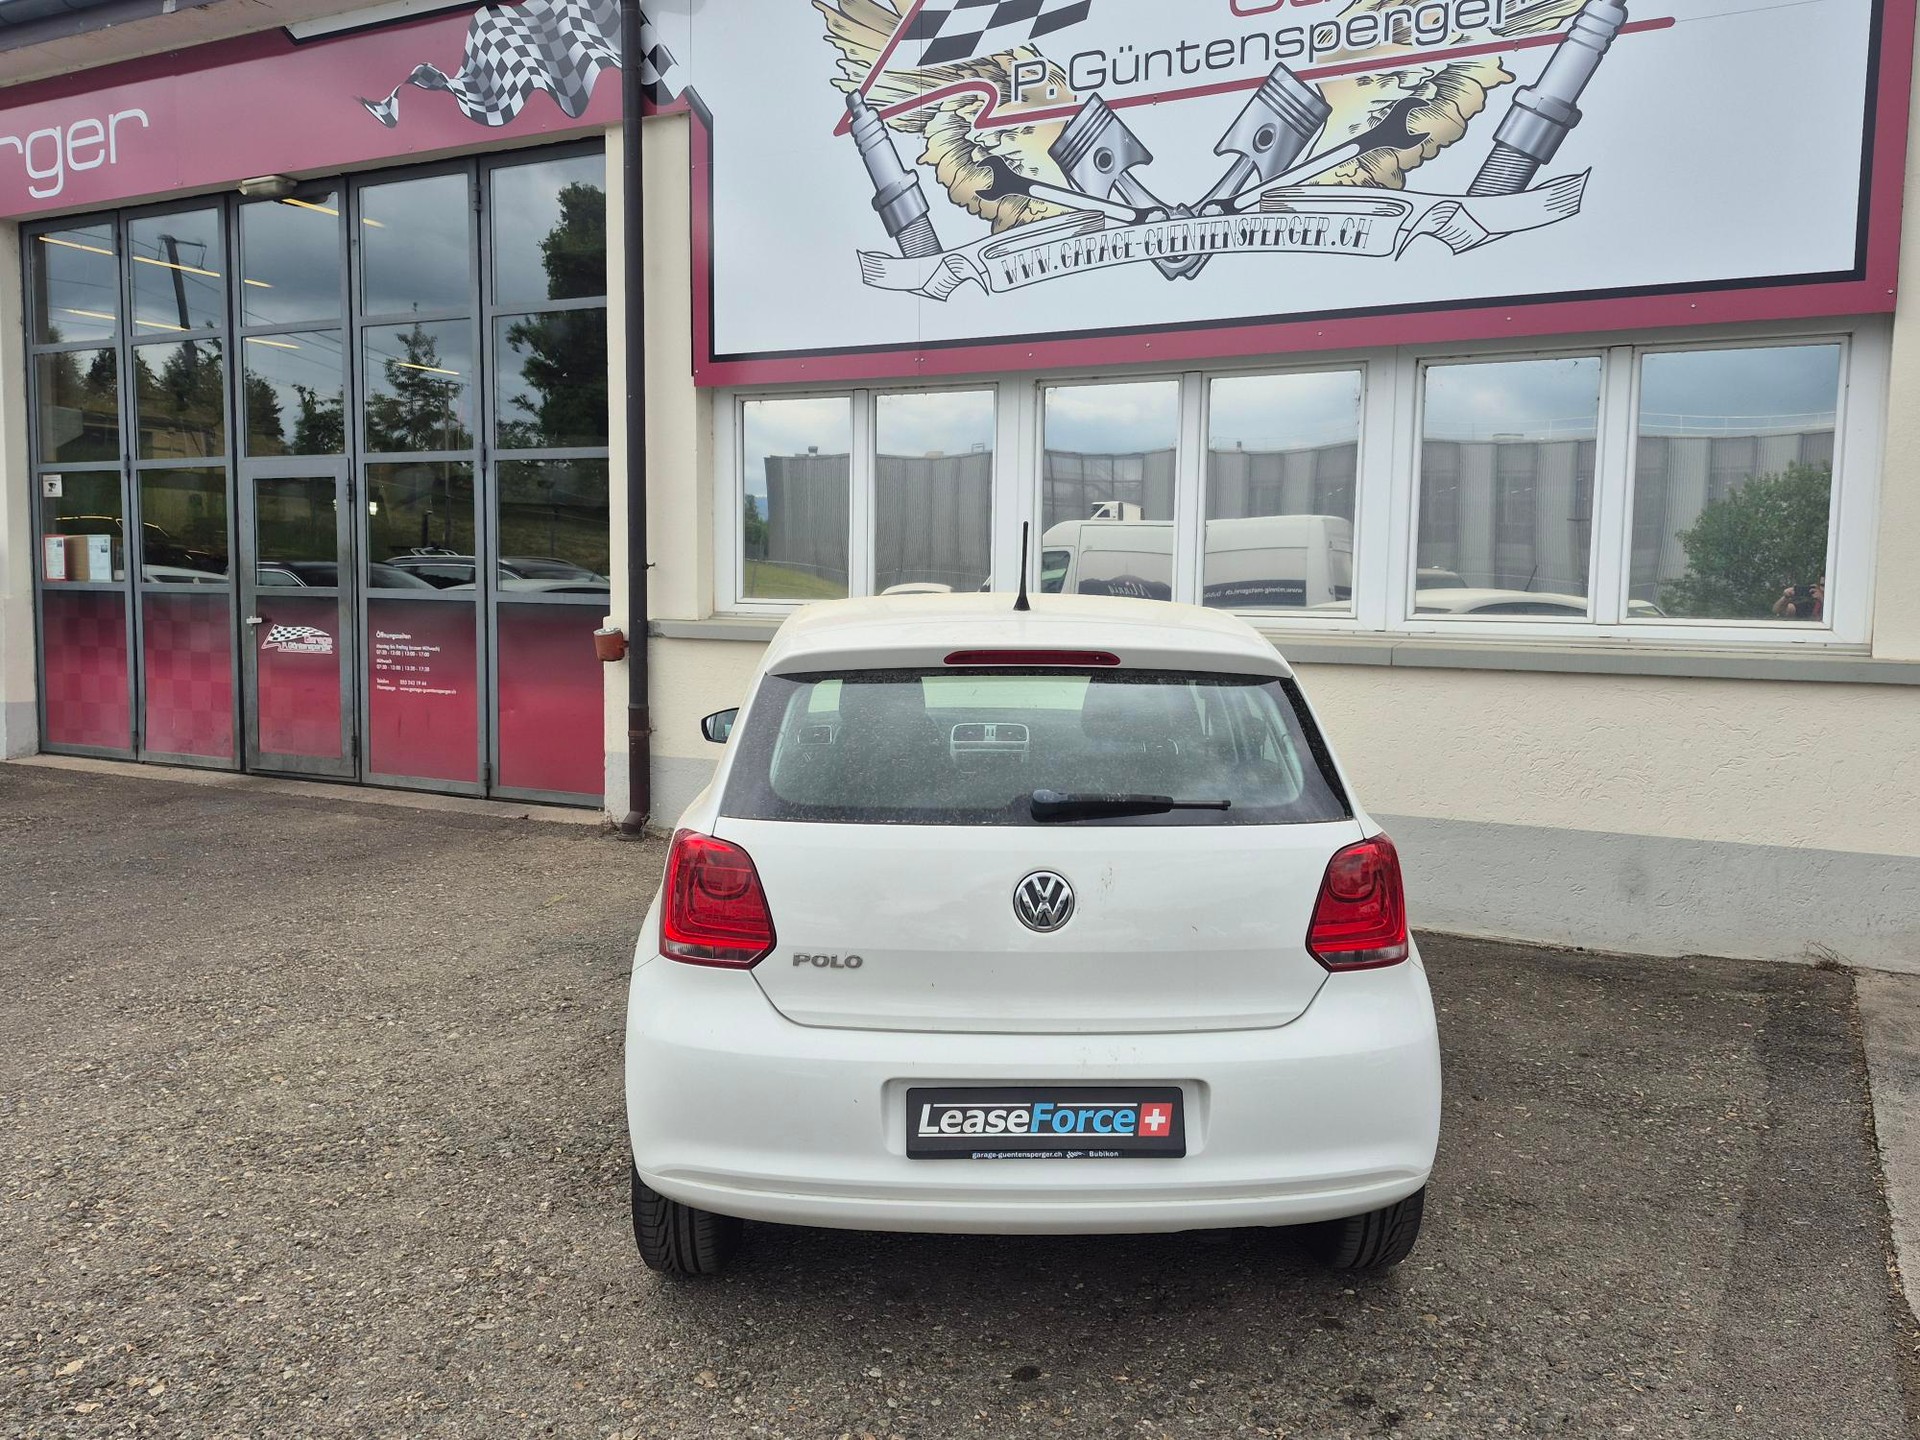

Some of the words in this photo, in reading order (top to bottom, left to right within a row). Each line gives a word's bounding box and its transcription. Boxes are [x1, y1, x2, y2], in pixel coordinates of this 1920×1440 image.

[1001, 216, 1374, 285] WWW.GARAGE-GUENTENSPERGER.CH
[792, 952, 864, 969] POLO
[918, 1102, 1137, 1134] LeaseForce
[1088, 1150, 1119, 1158] Bubikon
